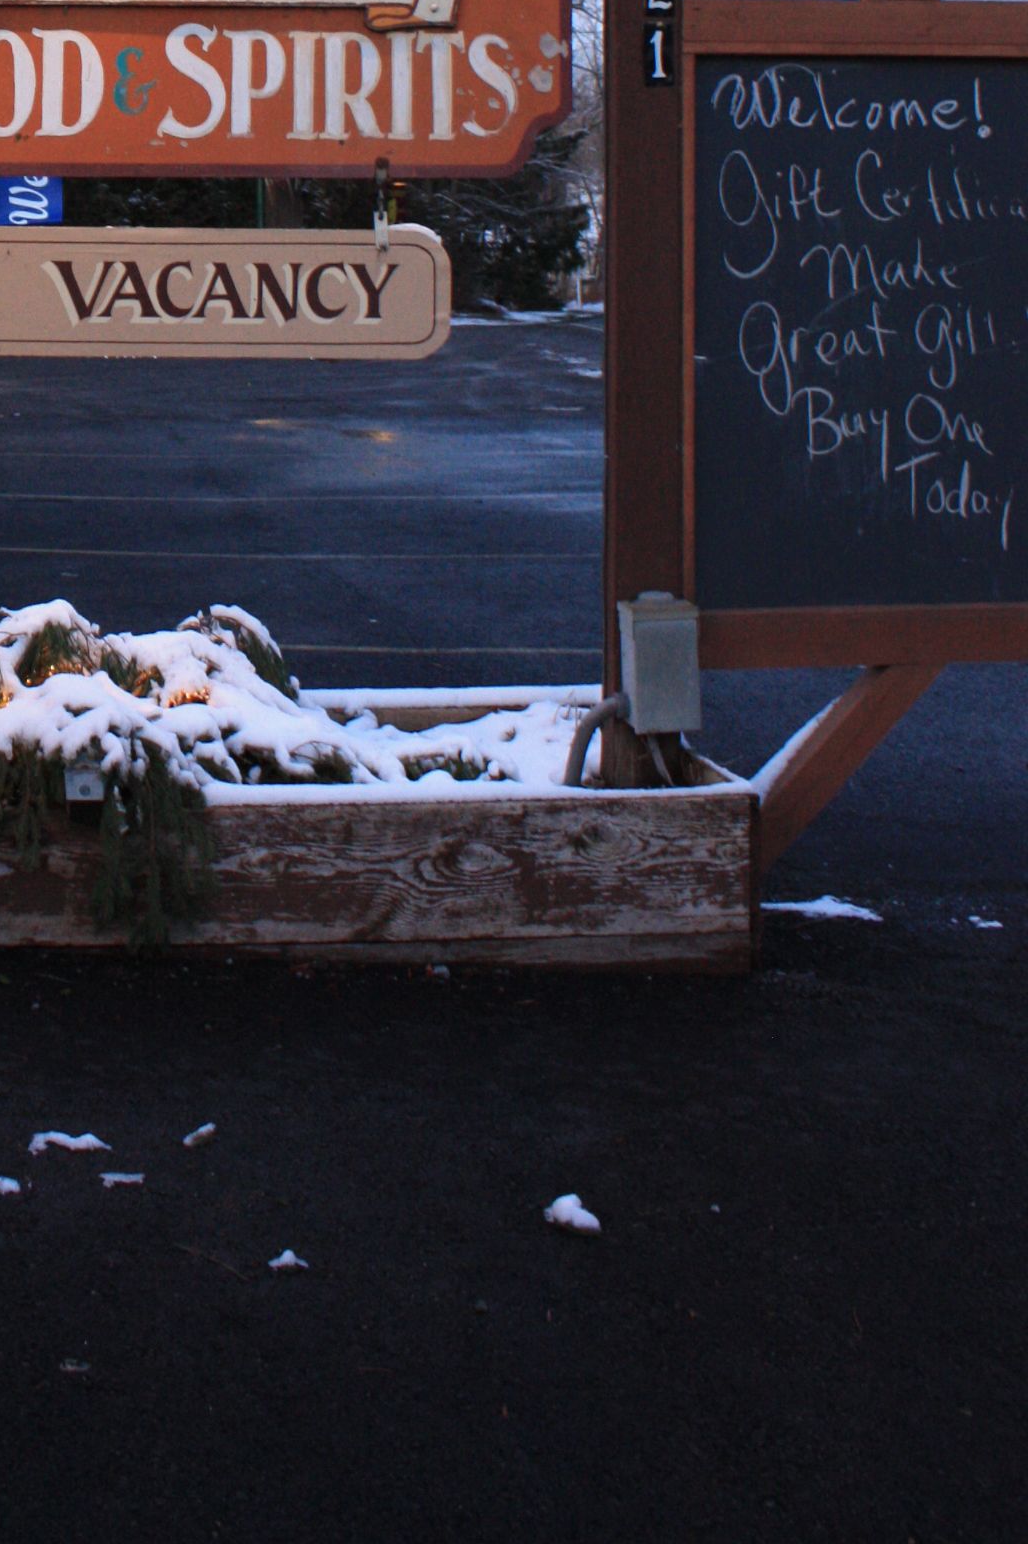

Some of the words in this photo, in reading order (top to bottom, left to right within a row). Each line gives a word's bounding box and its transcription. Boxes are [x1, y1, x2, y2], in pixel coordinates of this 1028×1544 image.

[113, 47, 157, 116] &
[157, 23, 519, 142] SPIRITS
[711, 63, 992, 138] Welcome!
[43, 260, 400, 325] VACANCY
[791, 387, 890, 483] Buy
[905, 394, 993, 455] One
[895, 452, 1014, 551] Today
